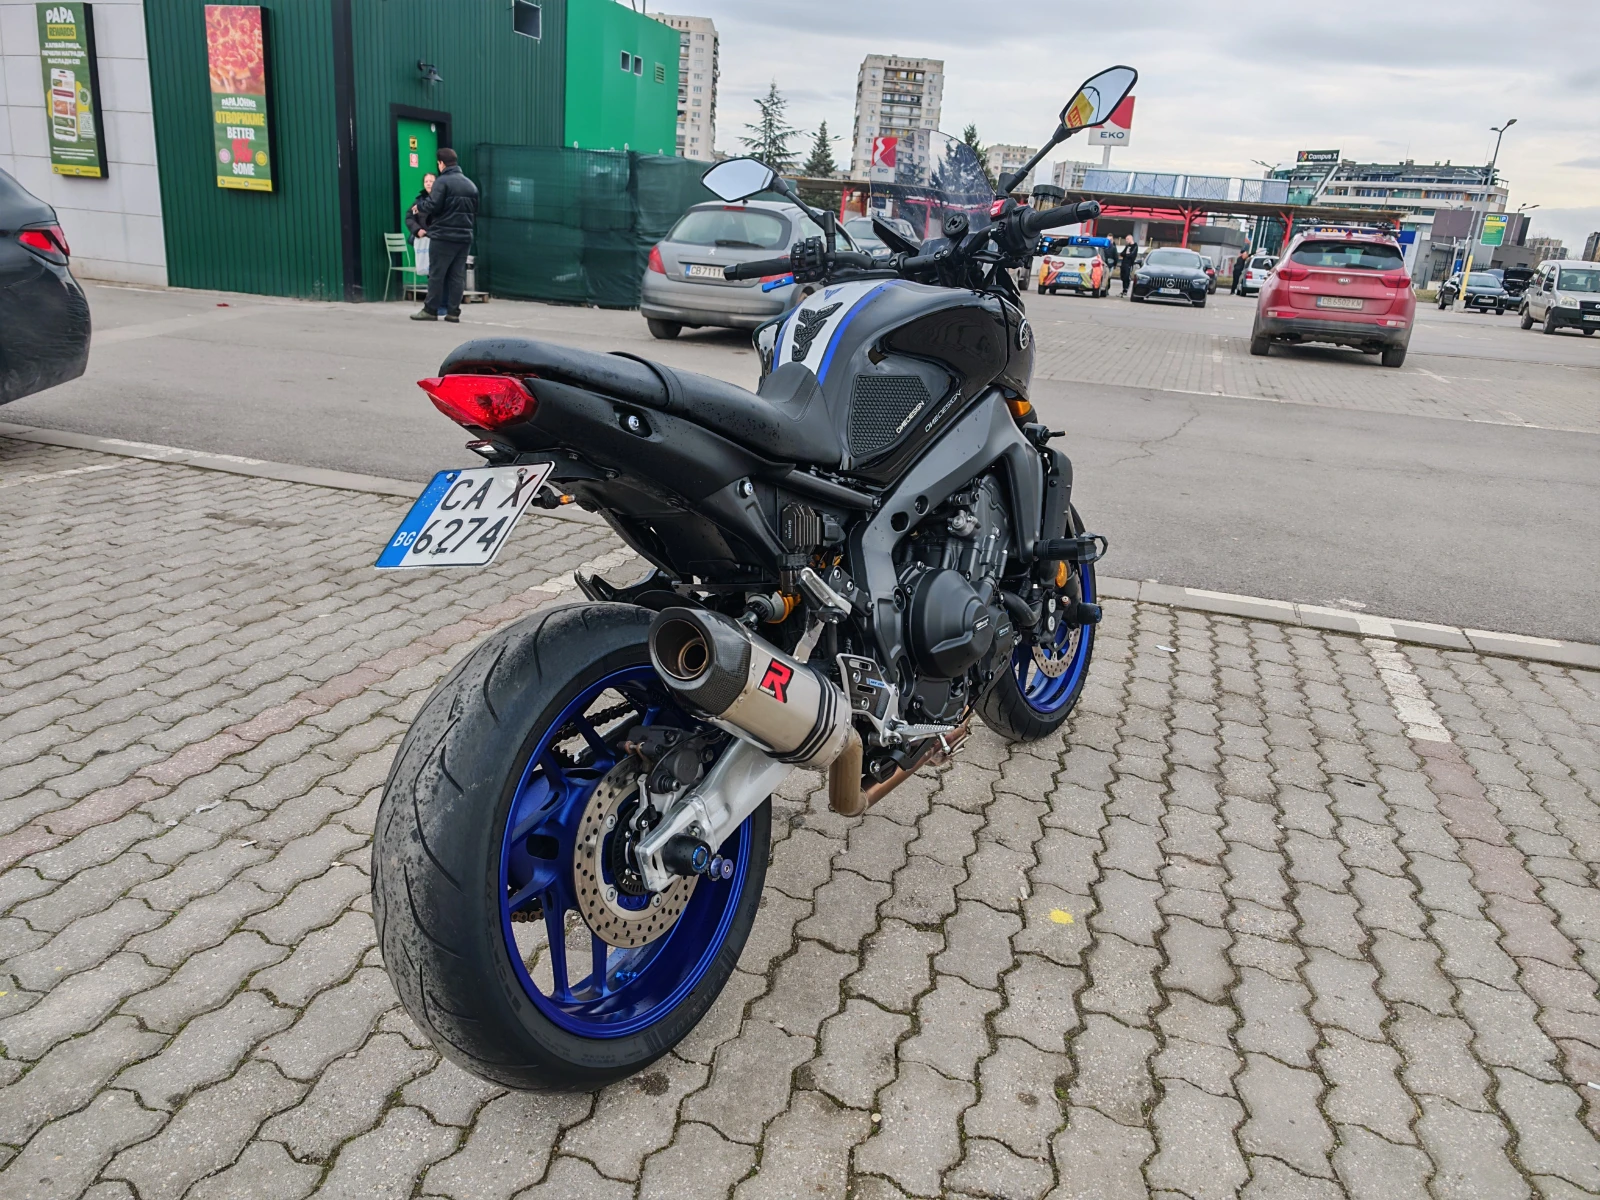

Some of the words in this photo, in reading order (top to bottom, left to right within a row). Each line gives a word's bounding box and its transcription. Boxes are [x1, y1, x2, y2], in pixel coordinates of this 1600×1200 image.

[46, 6, 75, 23] PAPA
[49, 27, 75, 36] REWARDS
[227, 127, 255, 139] BETTER
[232, 163, 255, 175] SOME
[441, 478, 494, 510] CA
[497, 474, 538, 508] X
[393, 531, 417, 547] BG
[412, 516, 508, 554] 6274
